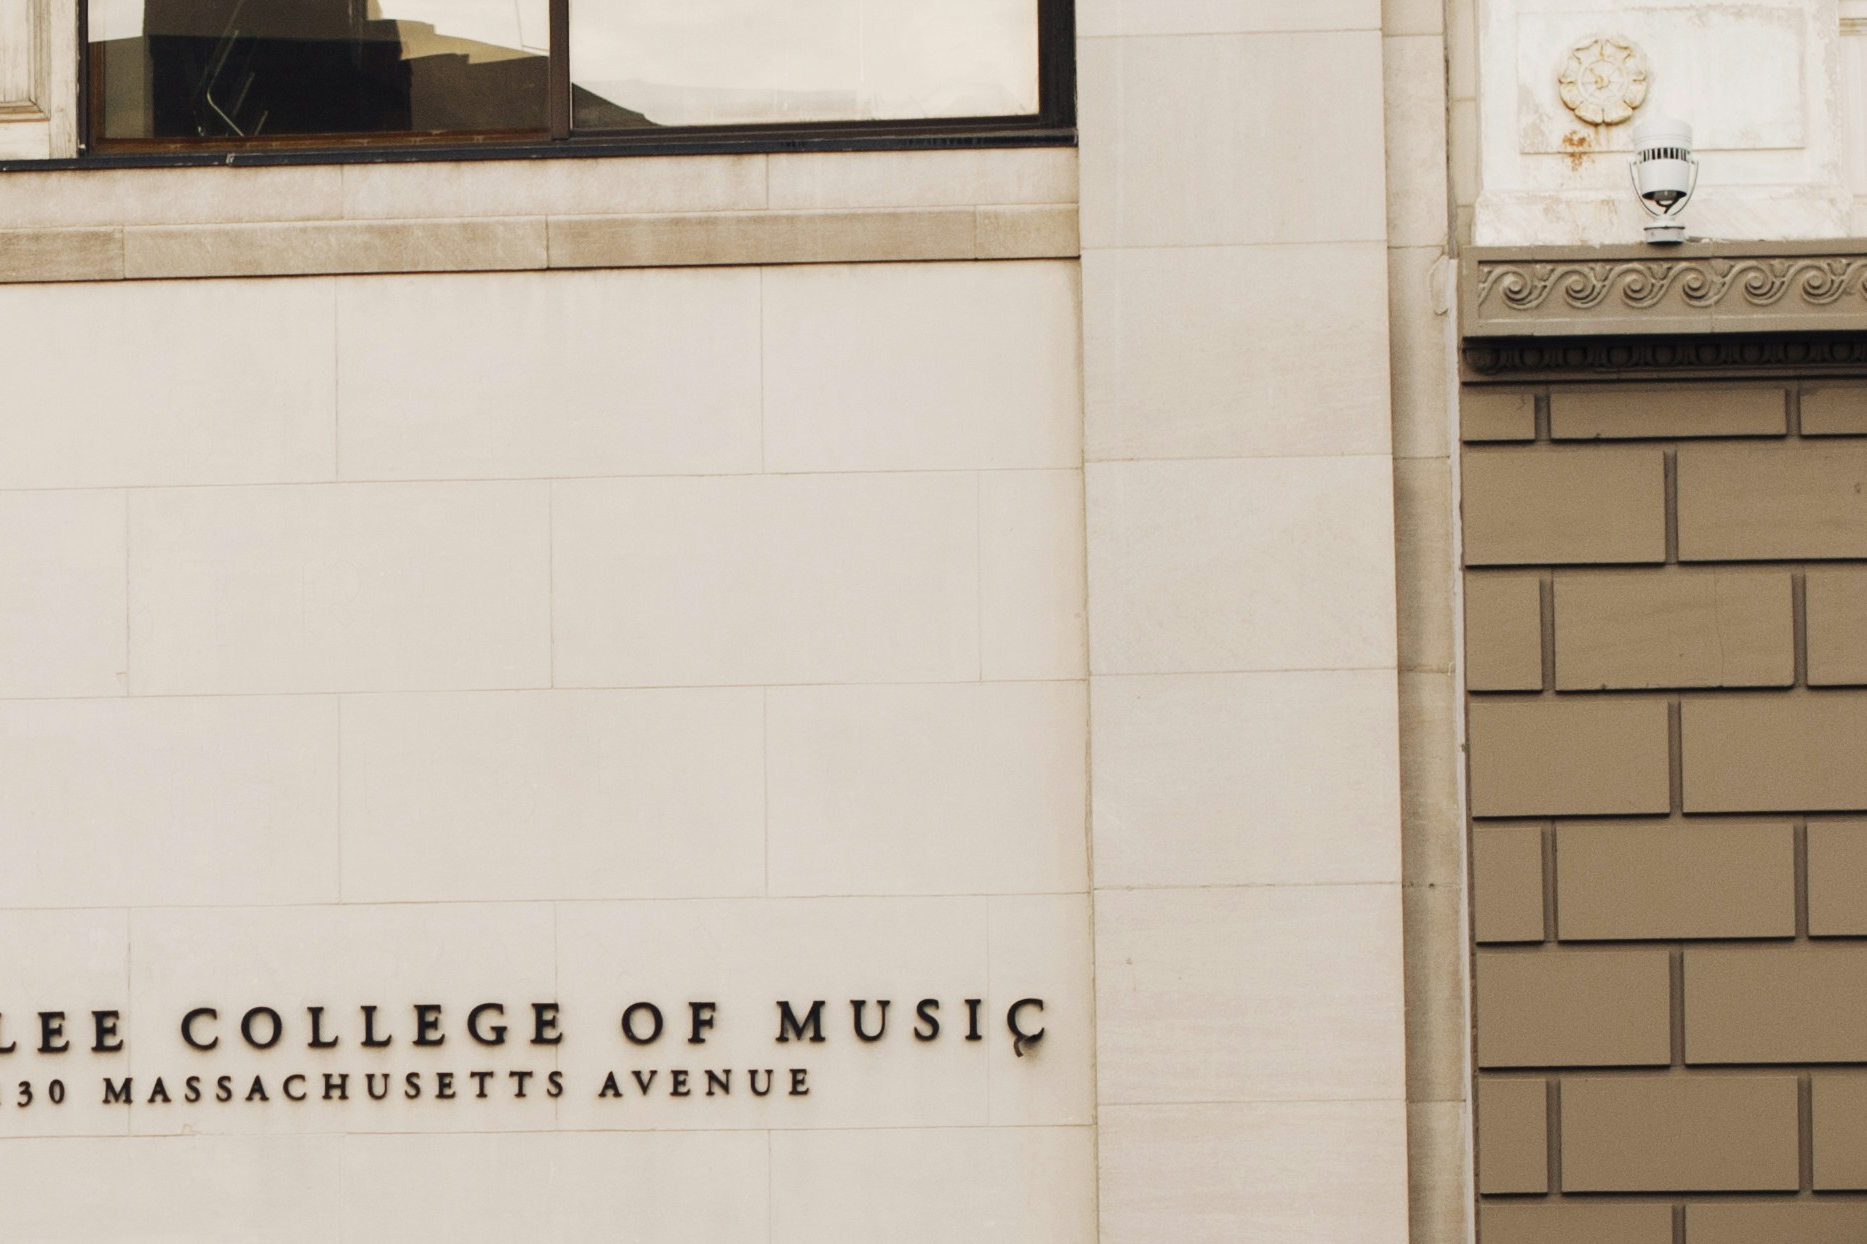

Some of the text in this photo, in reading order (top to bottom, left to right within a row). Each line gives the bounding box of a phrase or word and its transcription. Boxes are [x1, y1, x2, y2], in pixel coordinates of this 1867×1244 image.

[179, 1000, 565, 1054] COLLEGE
[619, 1000, 720, 1048] OF
[773, 997, 1047, 1058] MUSIC
[100, 1069, 565, 1107] MASSACHUSETTS
[596, 1067, 813, 1099] AVENUE
